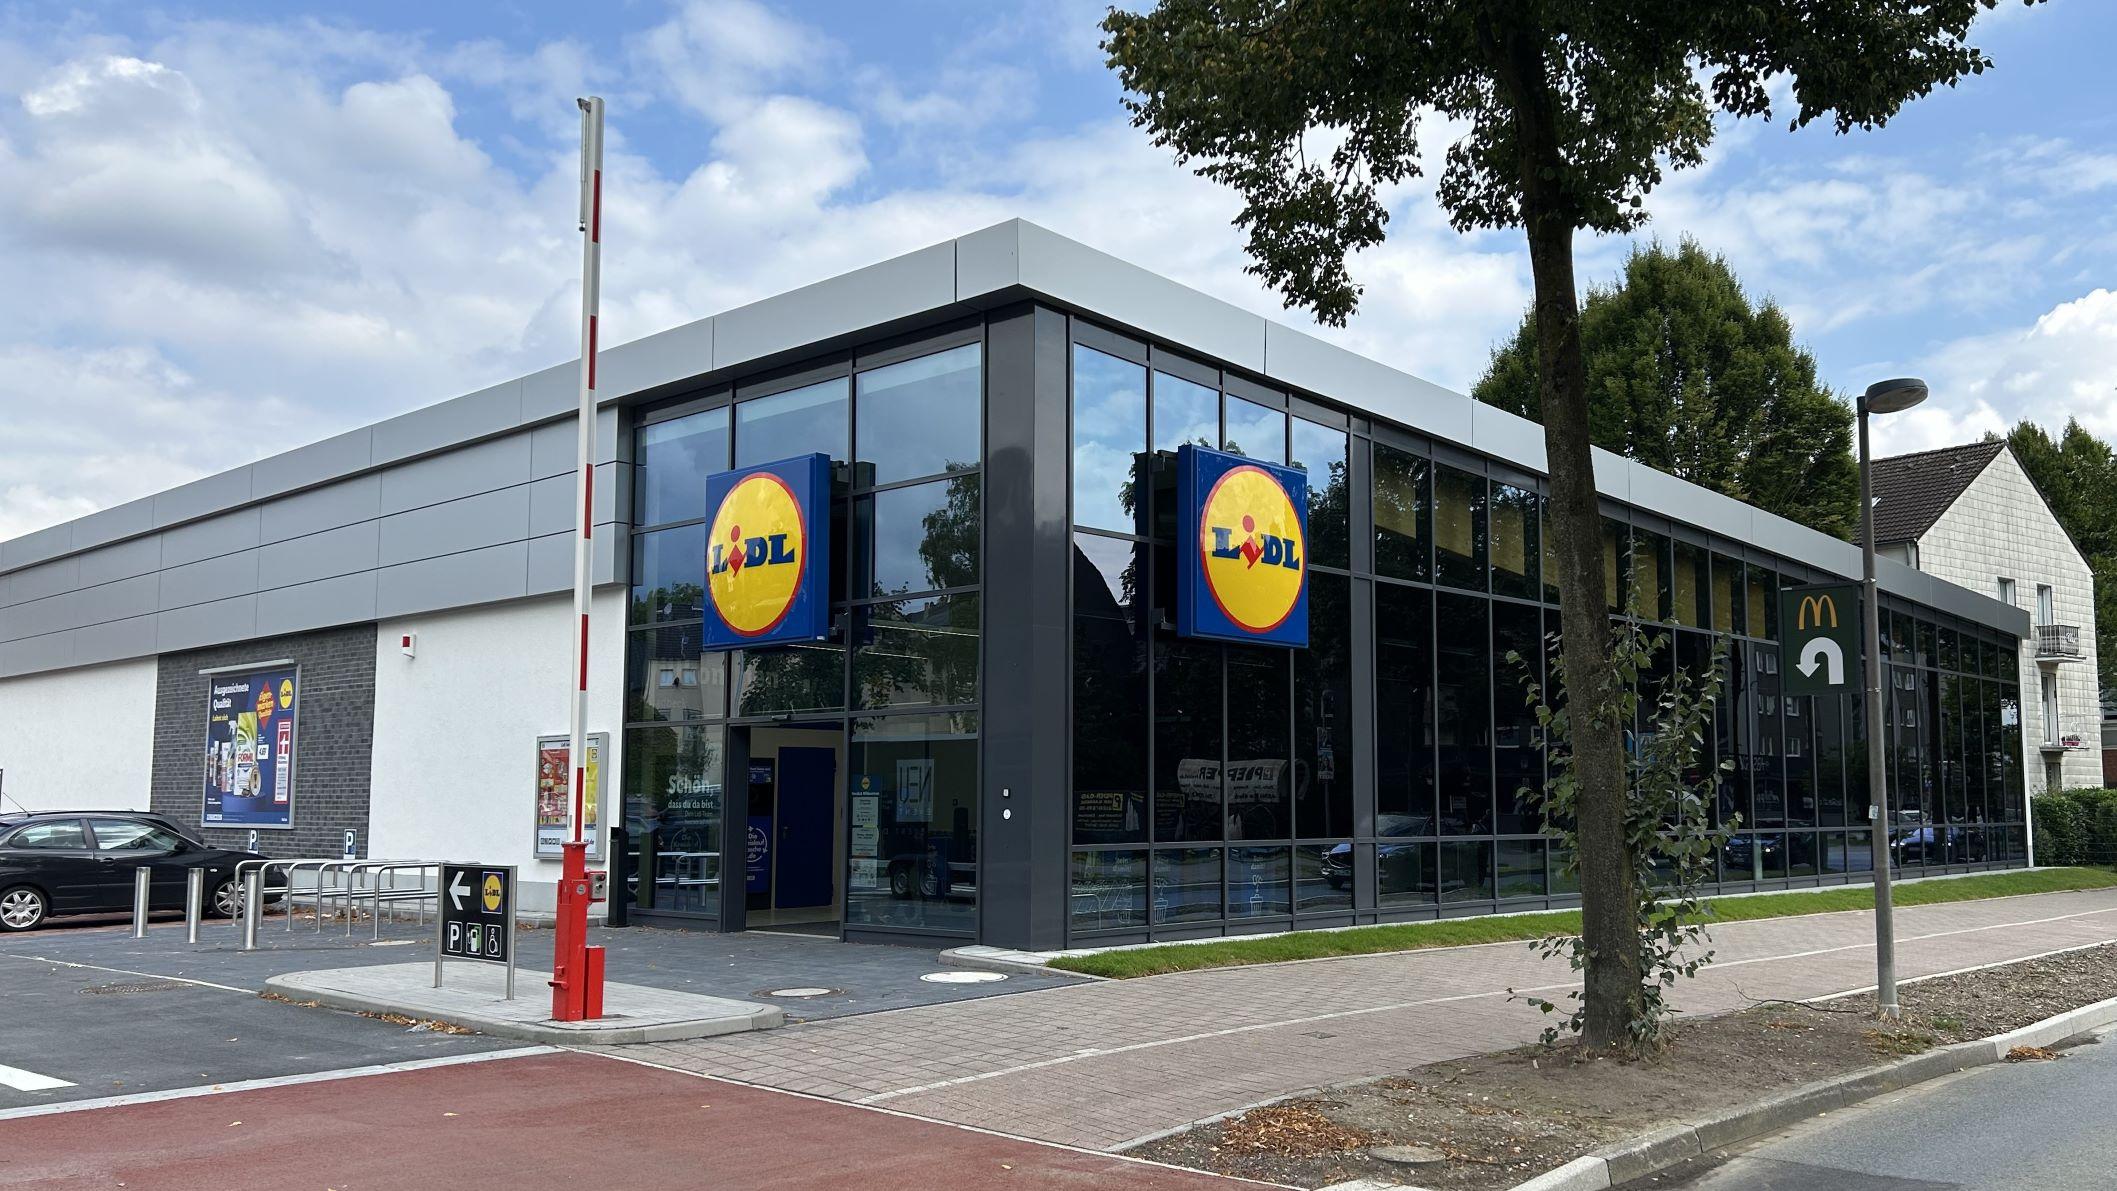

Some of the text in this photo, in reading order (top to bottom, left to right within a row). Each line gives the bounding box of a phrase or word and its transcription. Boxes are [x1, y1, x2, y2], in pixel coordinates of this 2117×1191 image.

[712, 525, 795, 578] LIDL
[1212, 514, 1299, 571] LIDL
[213, 698, 231, 711] Qualität
[669, 774, 713, 797] Schön,
[668, 799, 713, 809] dass du da bist
[249, 829, 257, 850] P
[345, 831, 354, 854] P
[449, 924, 460, 949] P
